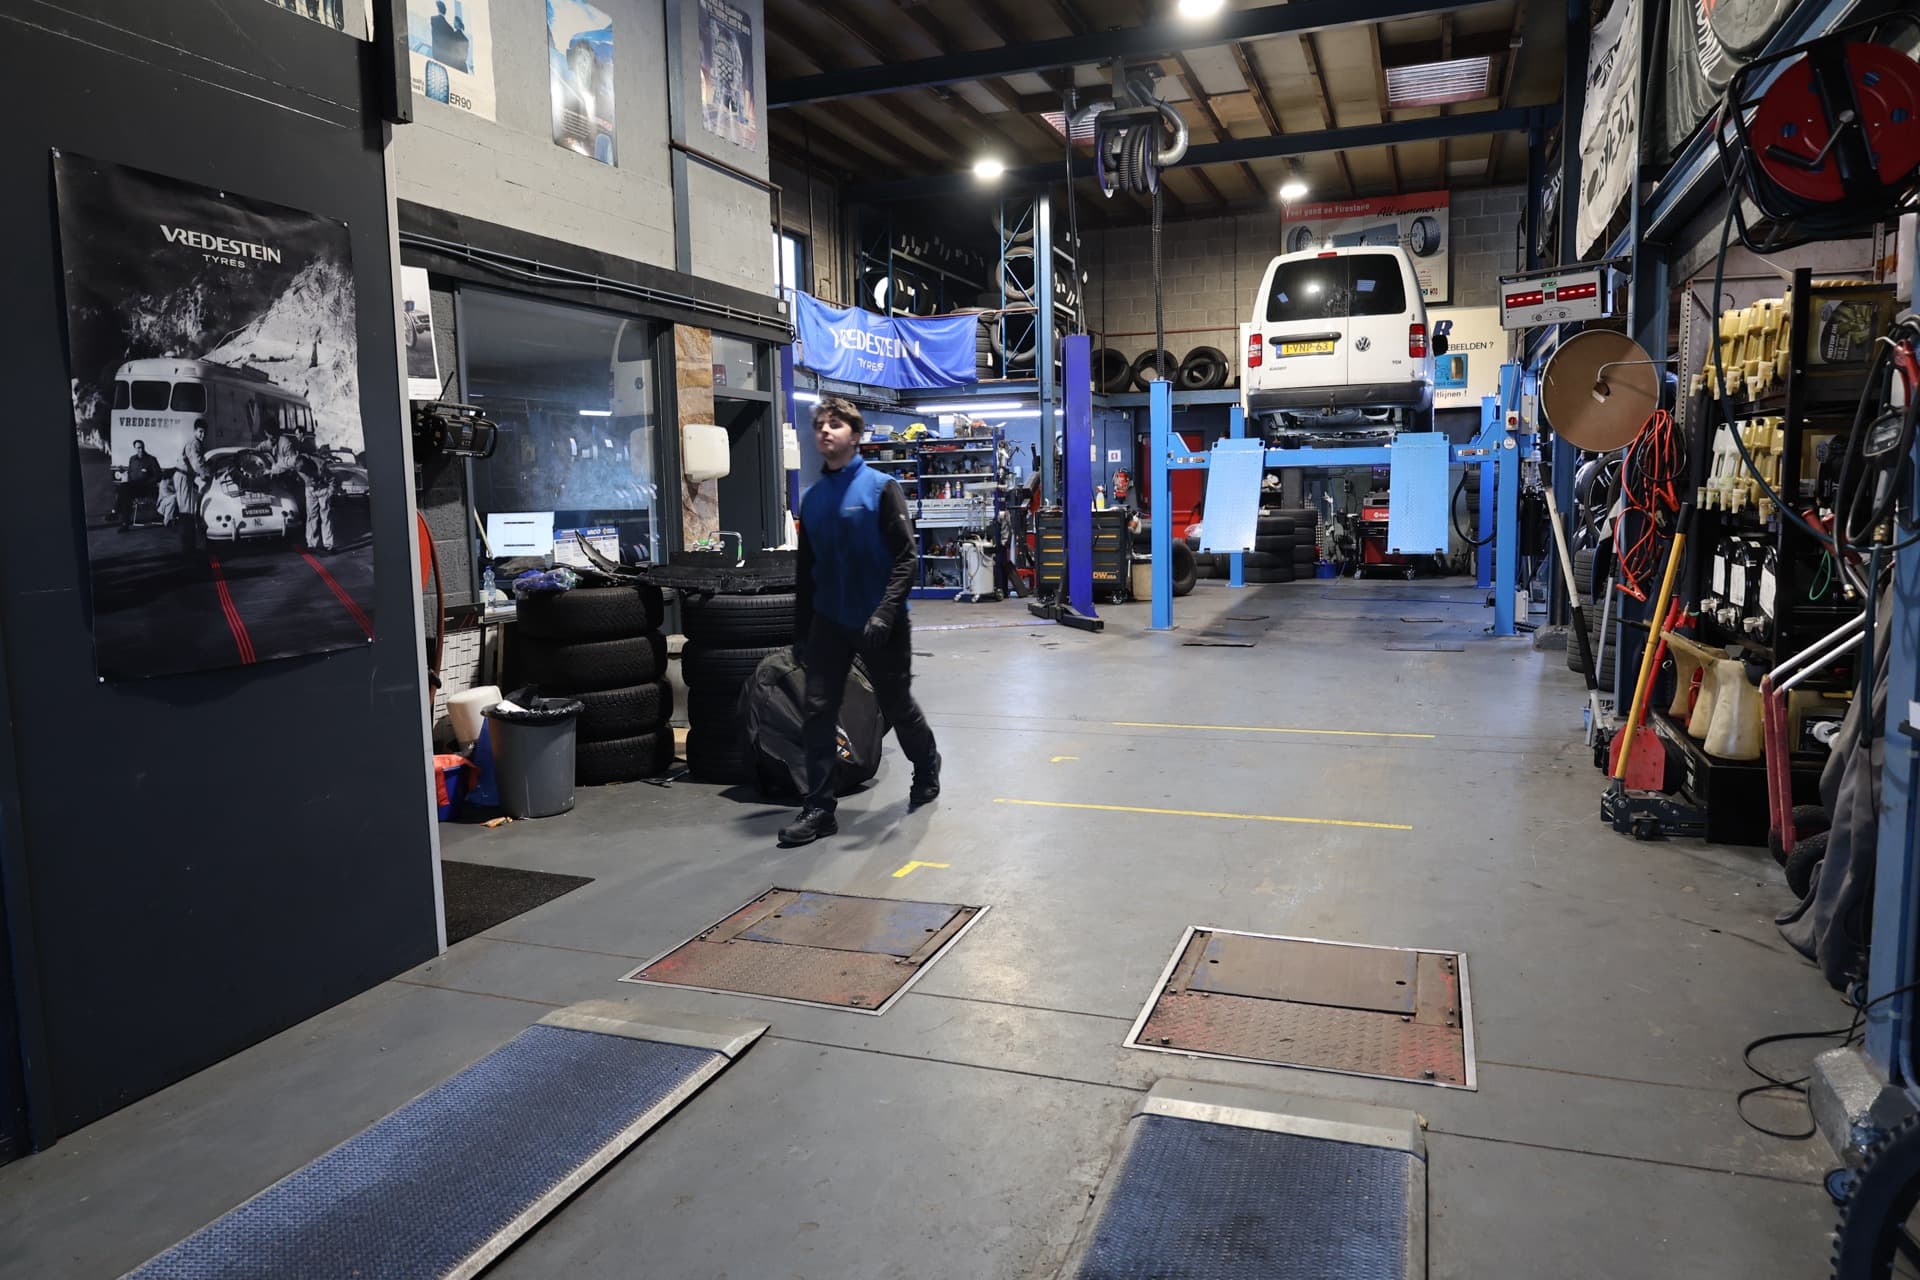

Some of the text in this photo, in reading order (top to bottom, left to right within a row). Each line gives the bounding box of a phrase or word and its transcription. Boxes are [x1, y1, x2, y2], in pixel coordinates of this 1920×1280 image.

[449, 93, 472, 110] ER90
[159, 224, 282, 264] VREDESTEIN
[202, 254, 246, 268] TYRES
[857, 357, 885, 372] TYRES
